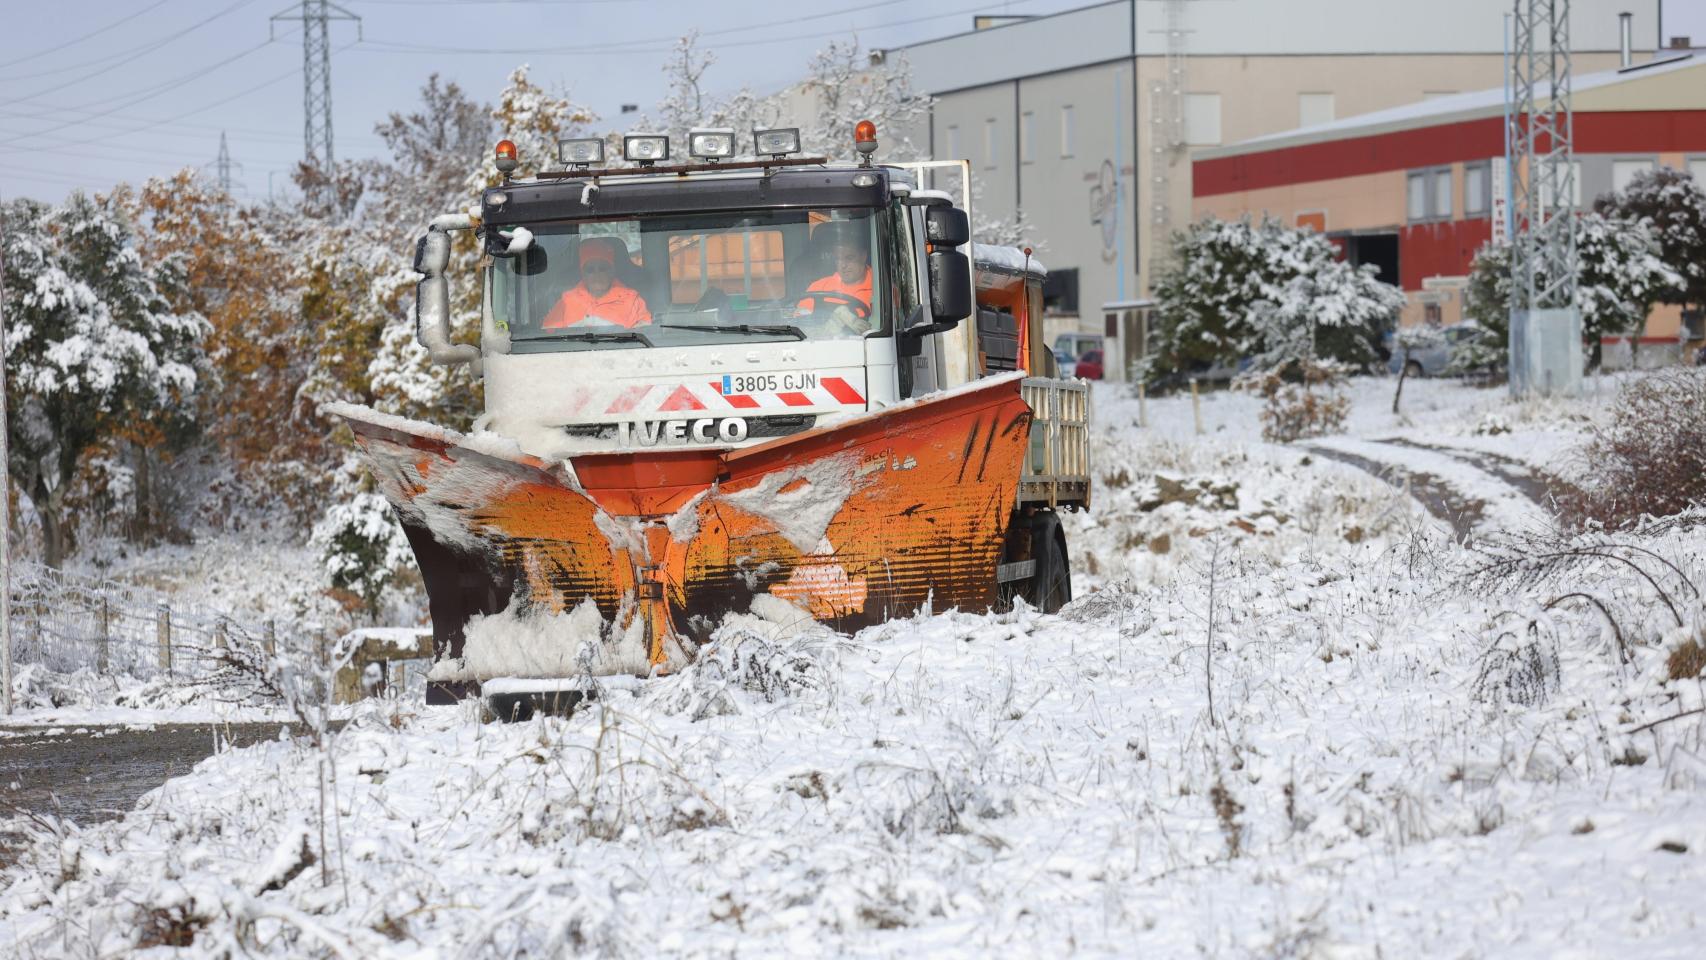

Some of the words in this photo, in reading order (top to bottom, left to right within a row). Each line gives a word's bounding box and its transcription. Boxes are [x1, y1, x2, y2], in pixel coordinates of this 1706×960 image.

[735, 375, 778, 393] 3805
[783, 373, 816, 390] GJN
[617, 417, 748, 448] IVECO
